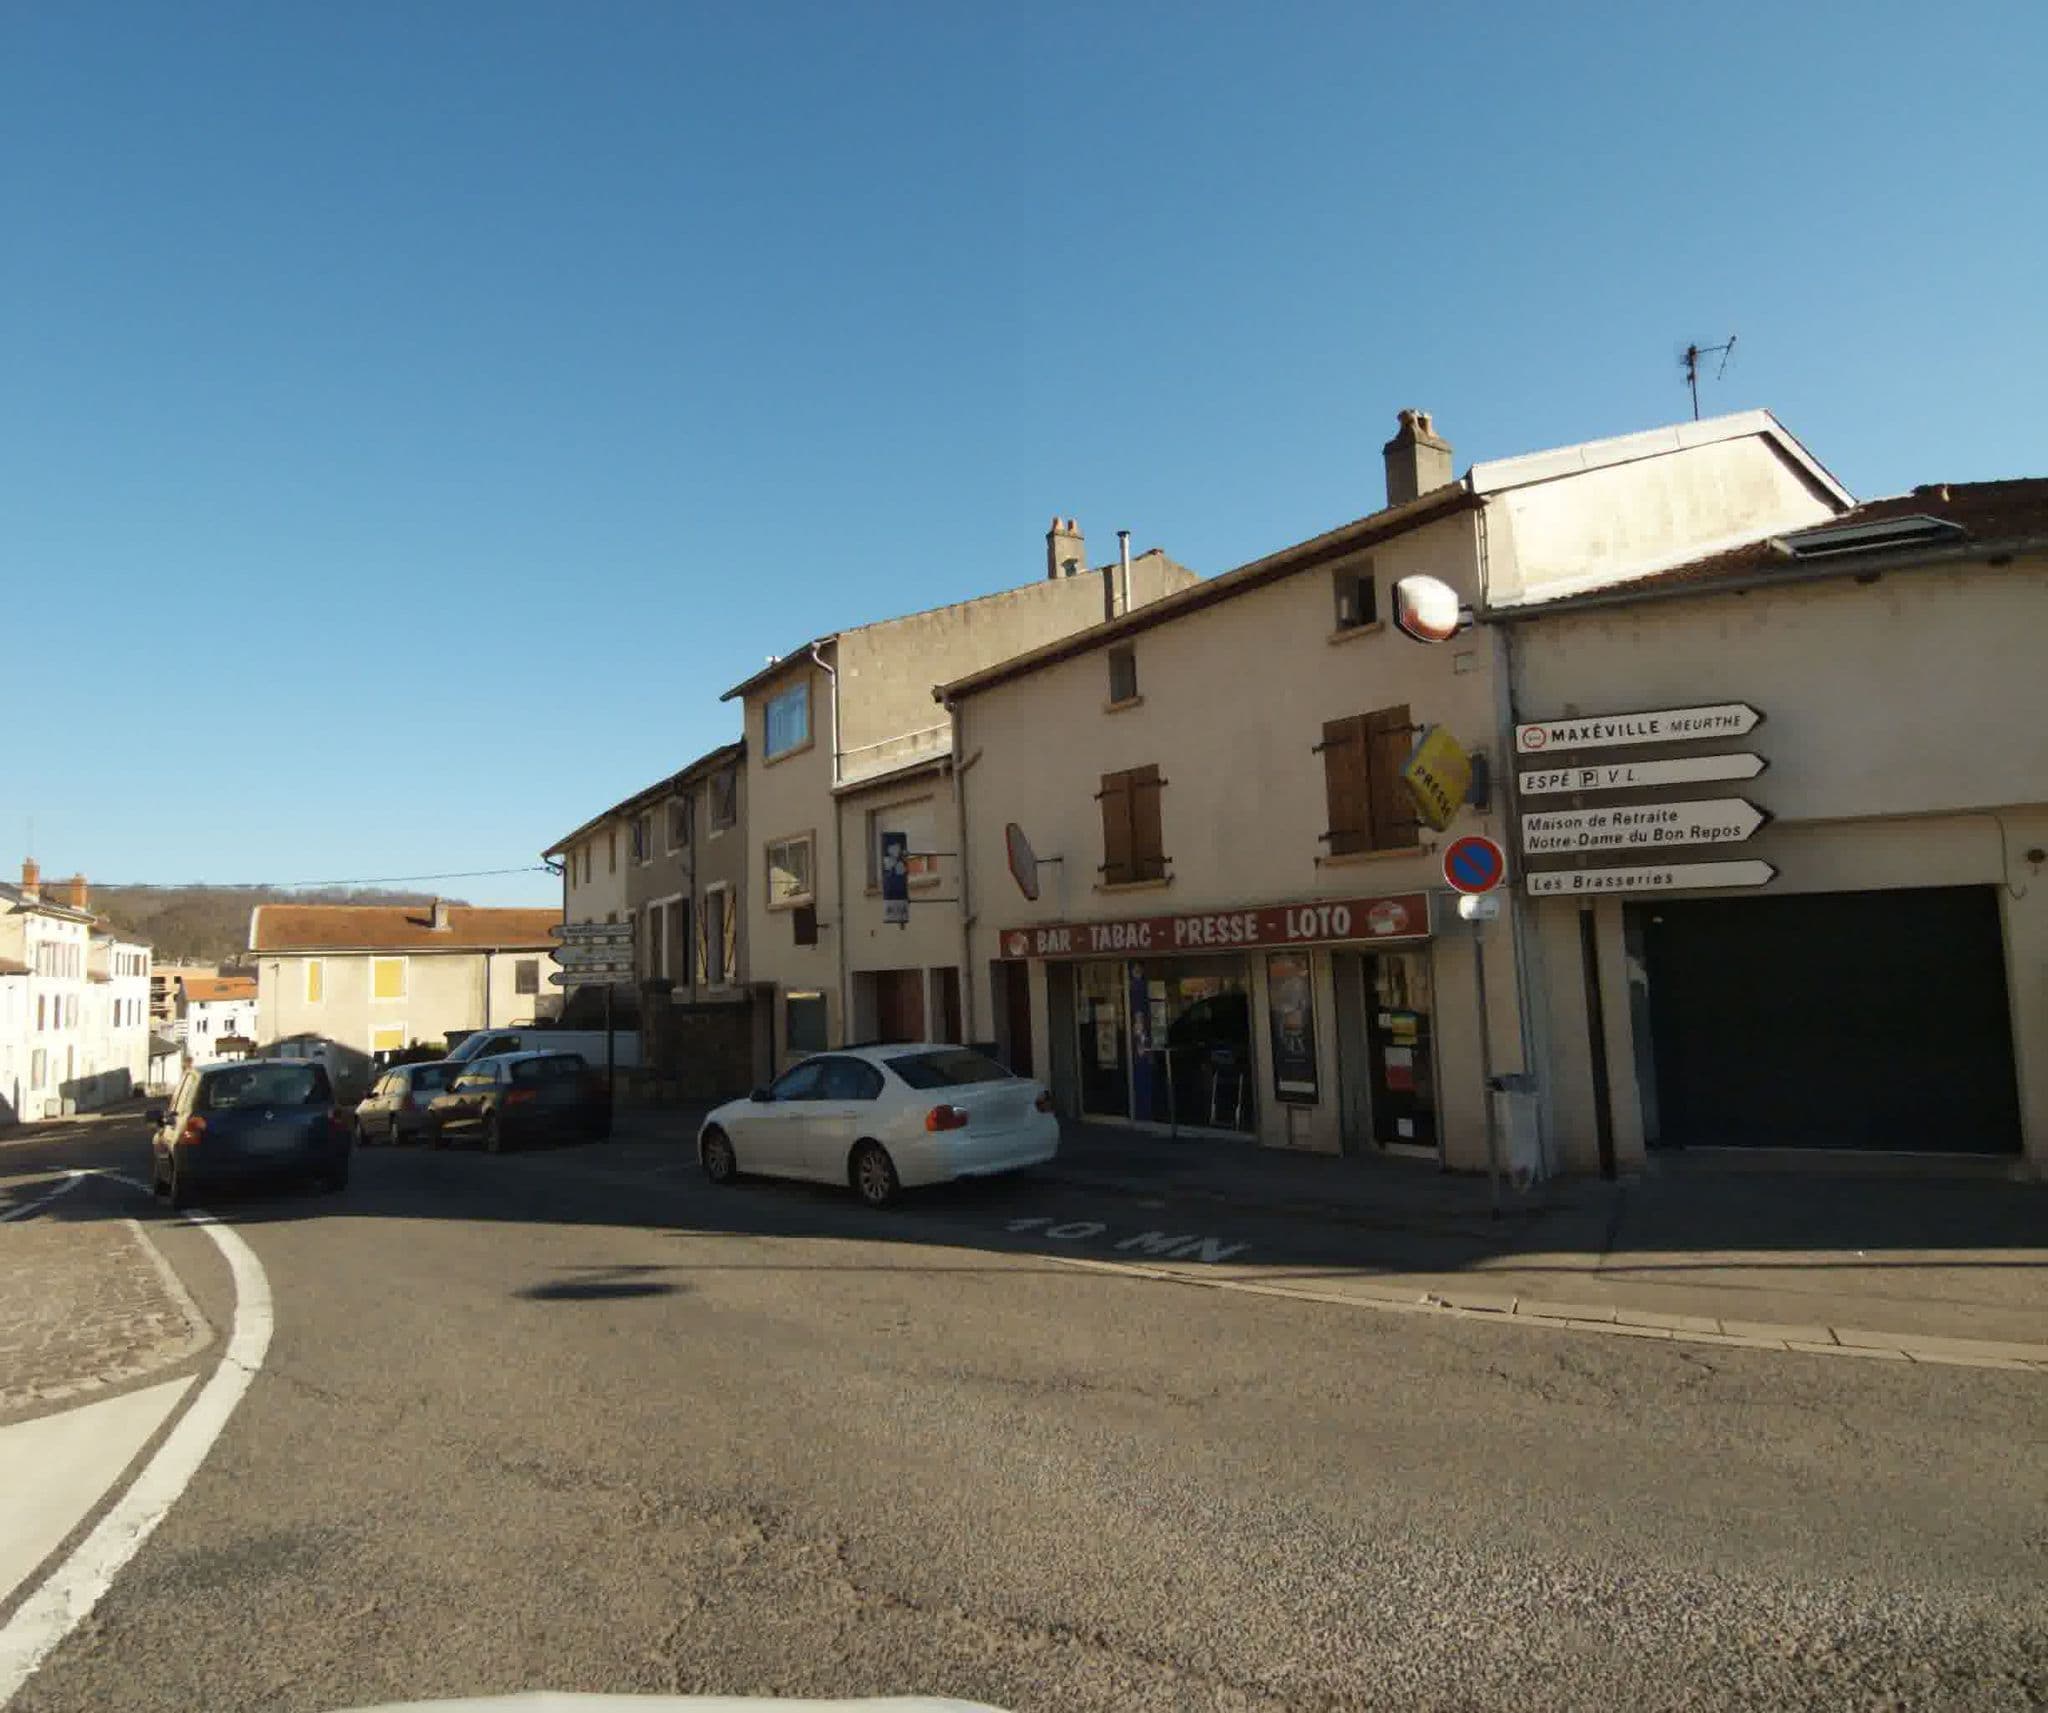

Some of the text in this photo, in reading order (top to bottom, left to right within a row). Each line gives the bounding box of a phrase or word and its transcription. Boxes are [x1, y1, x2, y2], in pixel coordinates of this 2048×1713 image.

[1551, 720, 1661, 743] MAXÉVILLE
[1670, 714, 1742, 732] MEURTHE
[1526, 771, 1570, 789] ESPÉ
[1527, 810, 1678, 831] Maison de Retraite
[1528, 824, 1741, 850] Notre-Dame du Bon Repos
[1533, 873, 1674, 891] Les Brasseries
[1036, 905, 1351, 954] BAR TABAC PRESSE LOTO
